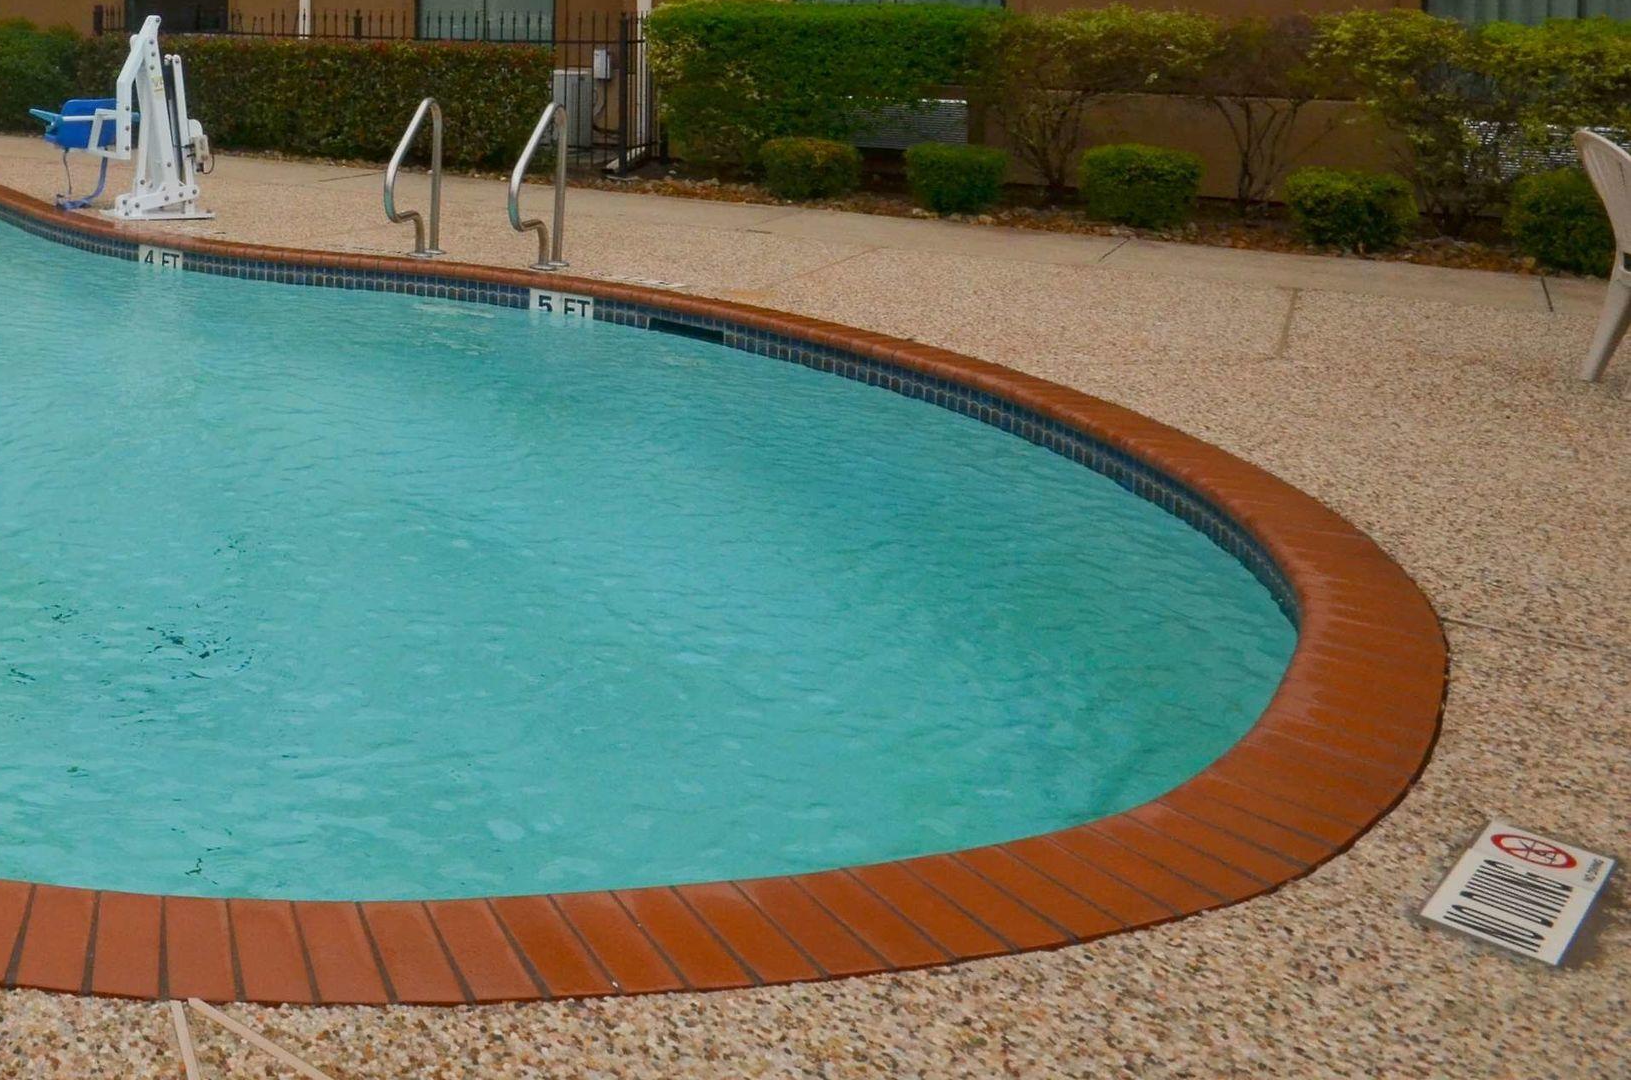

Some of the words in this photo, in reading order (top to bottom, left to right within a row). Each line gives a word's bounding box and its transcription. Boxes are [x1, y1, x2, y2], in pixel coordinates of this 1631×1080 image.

[144, 249, 154, 265] 4
[162, 252, 180, 269] FT
[539, 294, 553, 312] 5
[564, 297, 590, 317] FT
[1459, 859, 1573, 928] DIVING
[1443, 904, 1545, 953] NO
